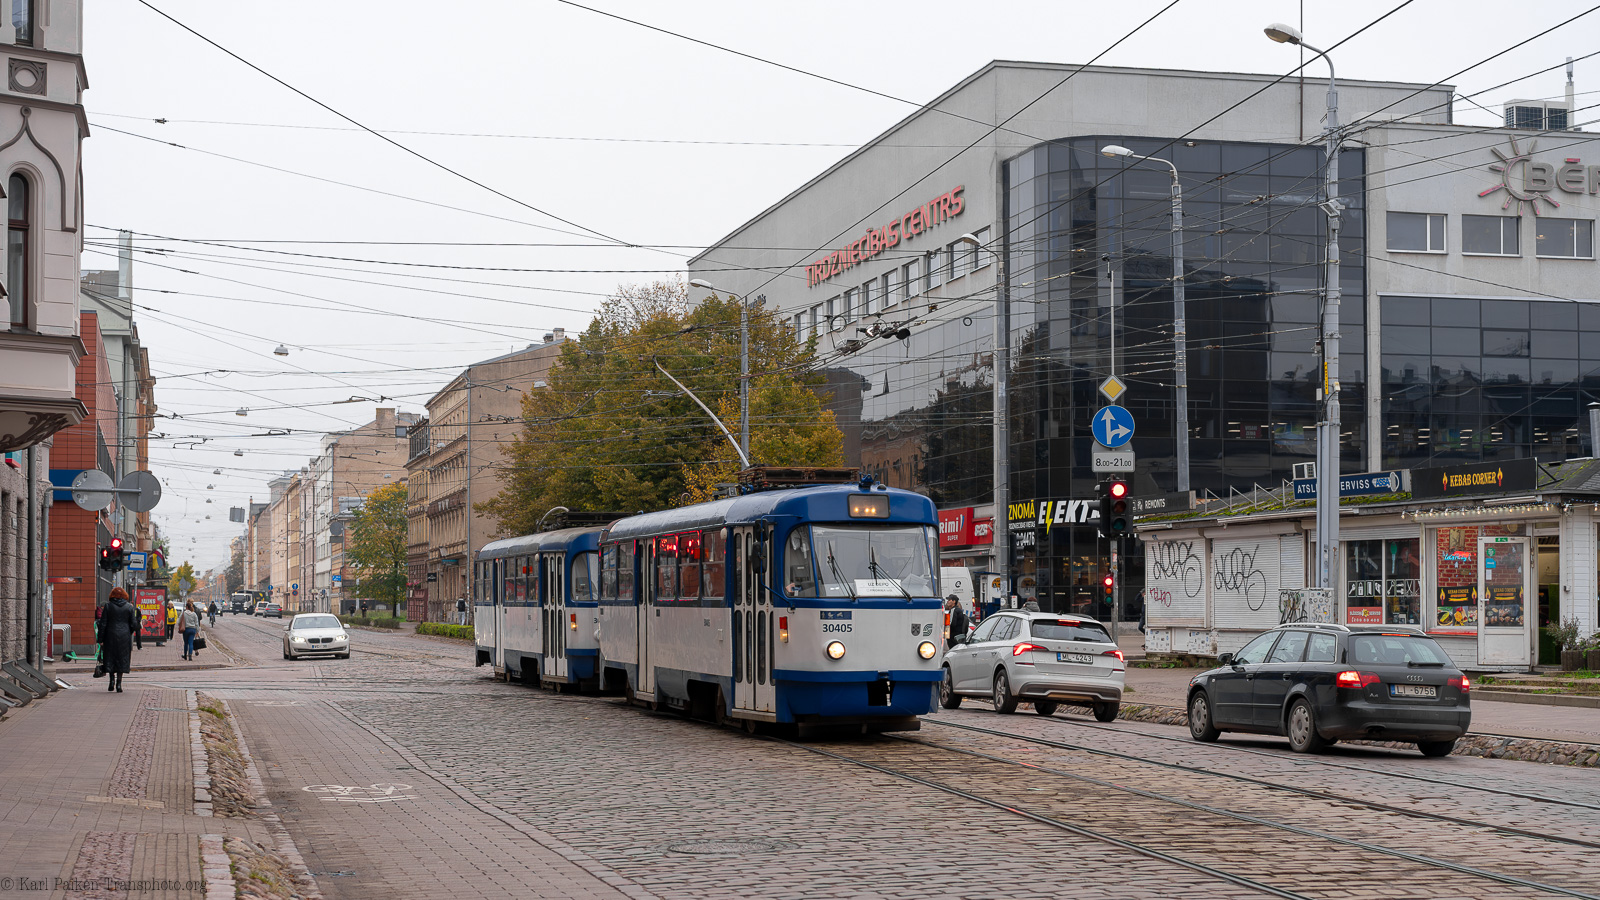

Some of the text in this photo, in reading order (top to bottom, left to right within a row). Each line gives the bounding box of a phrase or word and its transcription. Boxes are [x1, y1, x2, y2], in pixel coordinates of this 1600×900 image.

[805, 185, 965, 288] TIRDZNIECĪBAS CENTRS
[1095, 458, 1132, 467] 8.00-21.00
[1375, 477, 1391, 487] ASSA
[1450, 471, 1496, 487] KEBAB CORNER
[1340, 479, 1370, 491] ERVISS
[1145, 498, 1166, 509] REMONTS
[1008, 499, 1036, 520] ZNOMĀ
[822, 623, 853, 633] 30405
